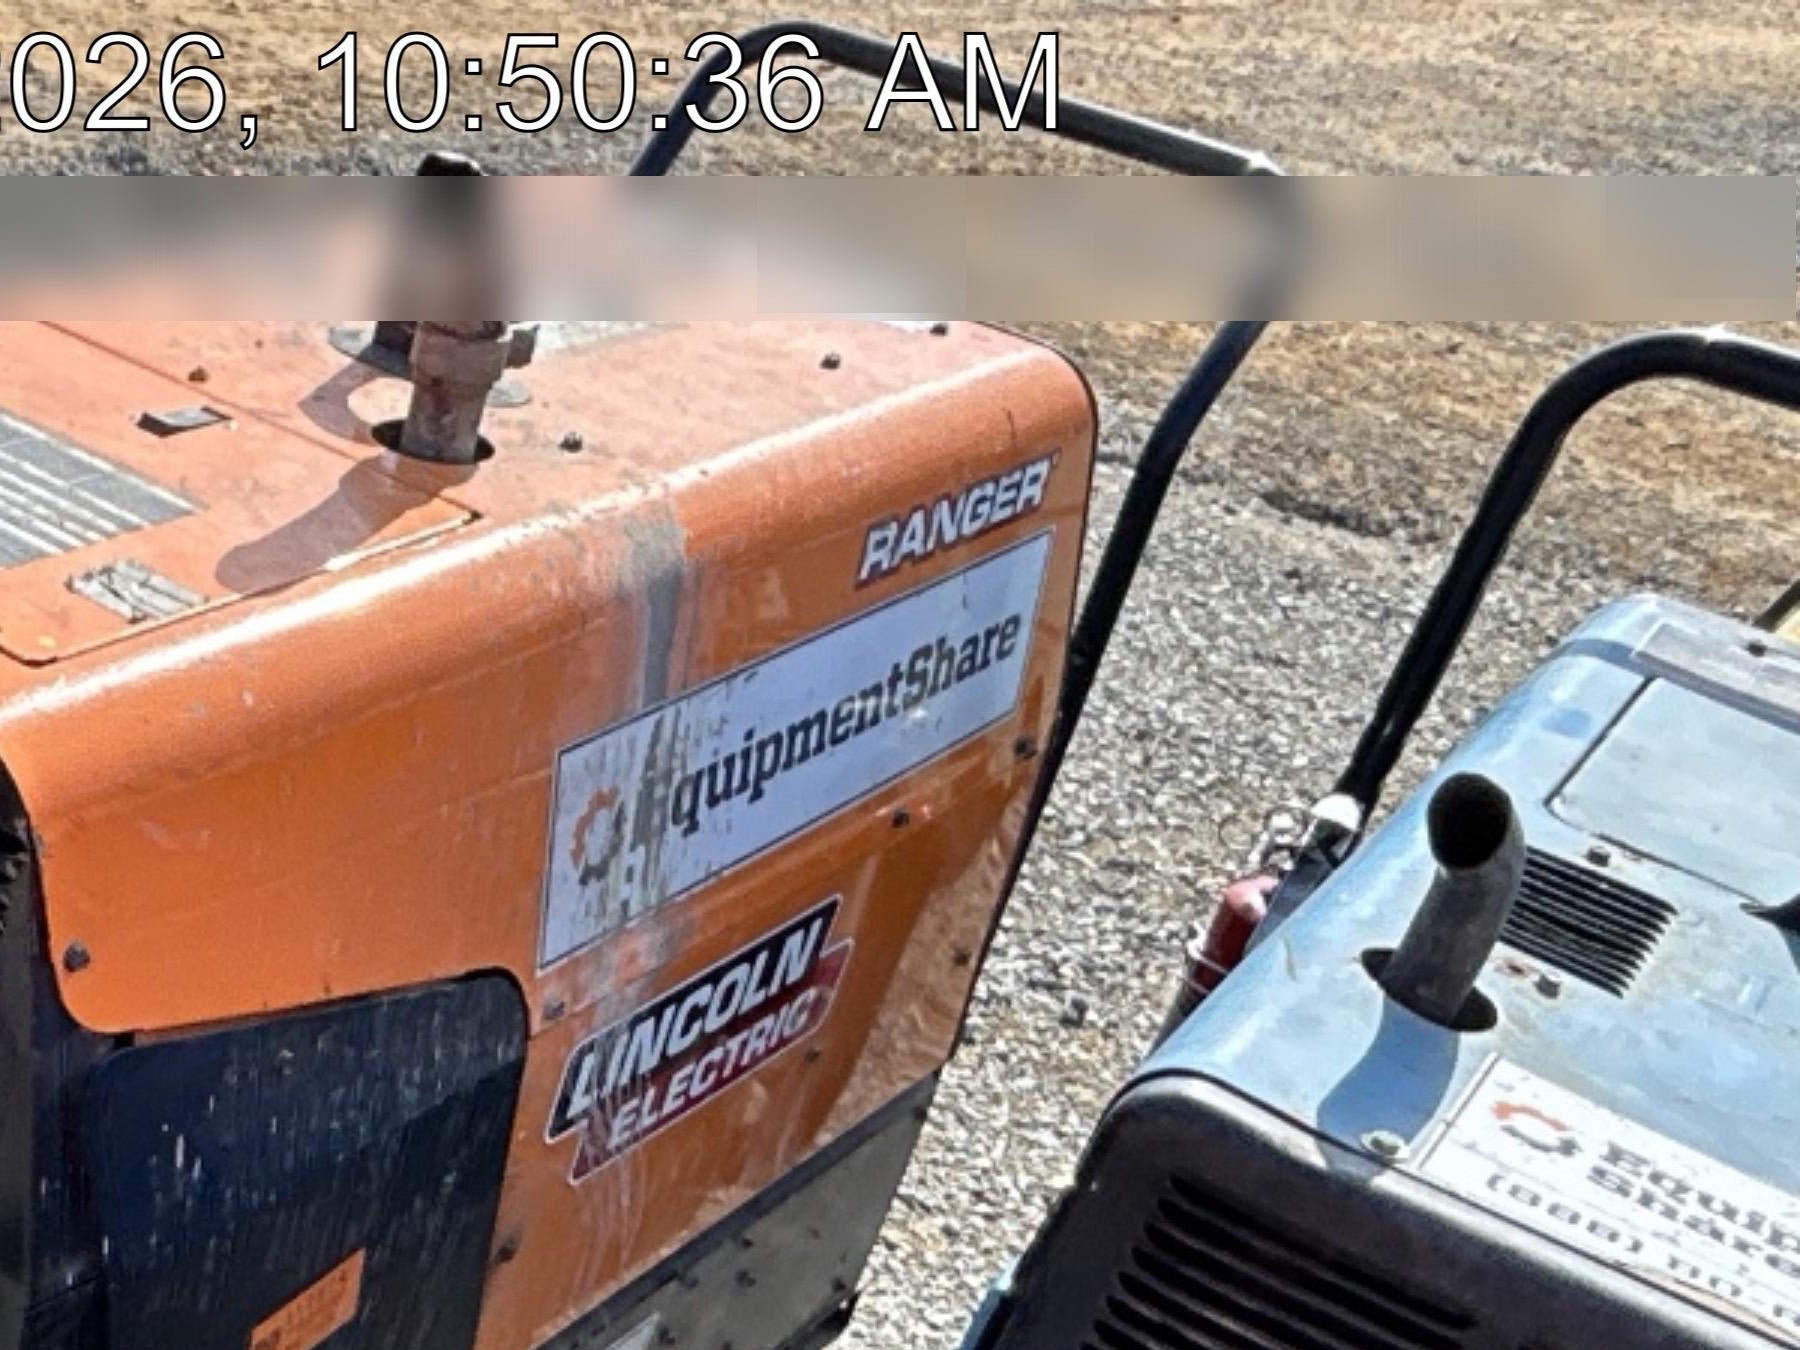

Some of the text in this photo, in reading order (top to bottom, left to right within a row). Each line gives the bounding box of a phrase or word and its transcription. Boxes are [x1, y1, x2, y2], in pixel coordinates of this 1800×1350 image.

[856, 457, 1052, 586] RANGER
[565, 916, 824, 1119] LINCOLN
[606, 987, 817, 1149] ELECTRIC
